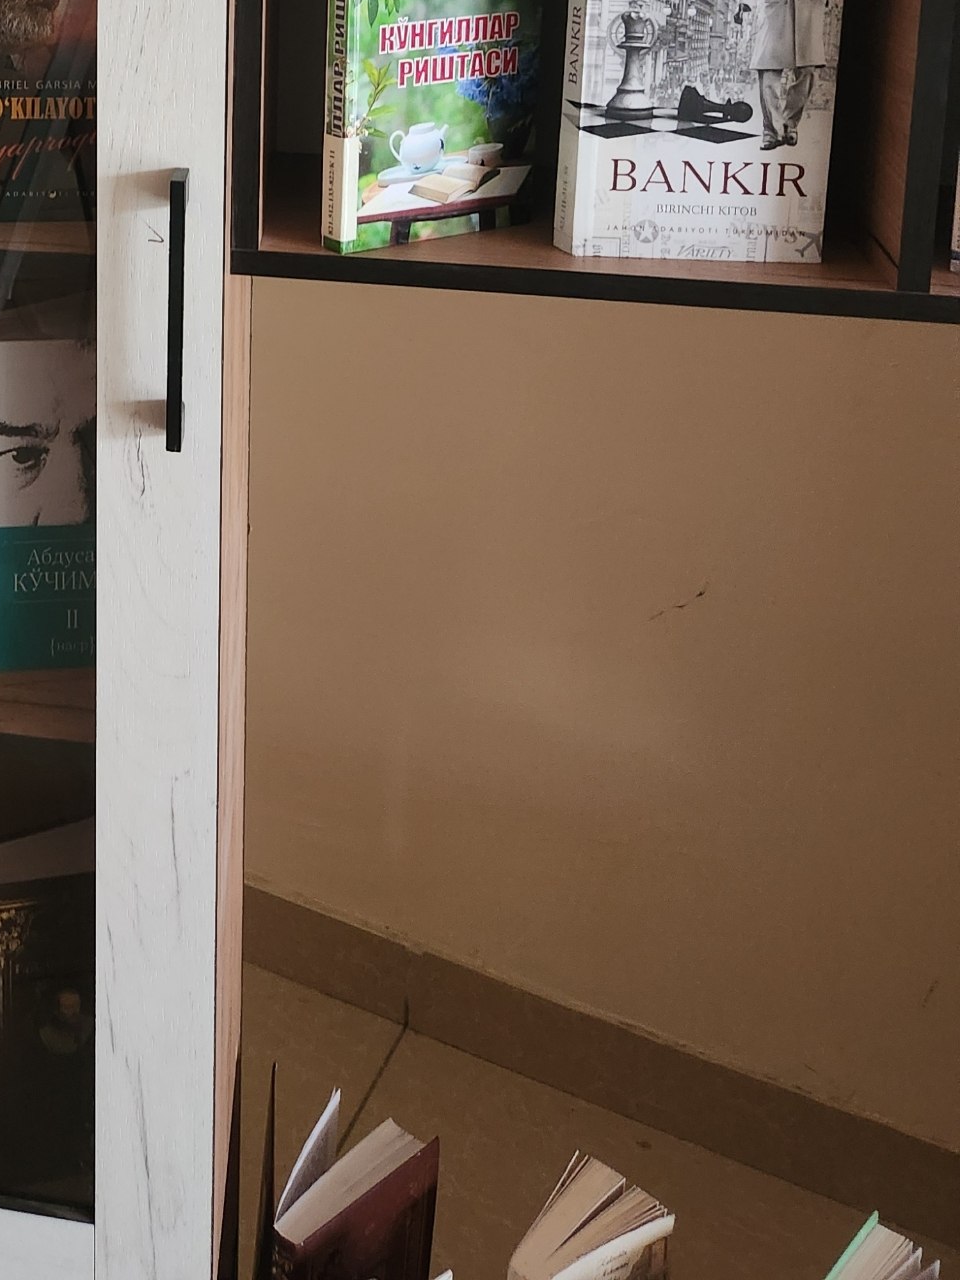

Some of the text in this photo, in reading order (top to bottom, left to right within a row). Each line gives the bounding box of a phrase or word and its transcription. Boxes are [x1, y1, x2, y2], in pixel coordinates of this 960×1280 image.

[379, 11, 519, 54] КЎНГИЛЛАР
[568, 6, 582, 85] BANKIR
[397, 47, 519, 88] РИШТАСИ
[609, 158, 808, 197] BANKIR
[656, 204, 758, 217] BIRINCHI KITOB
[606, 224, 806, 238] JAHON ADABIYOTI TURKUMIDAN
